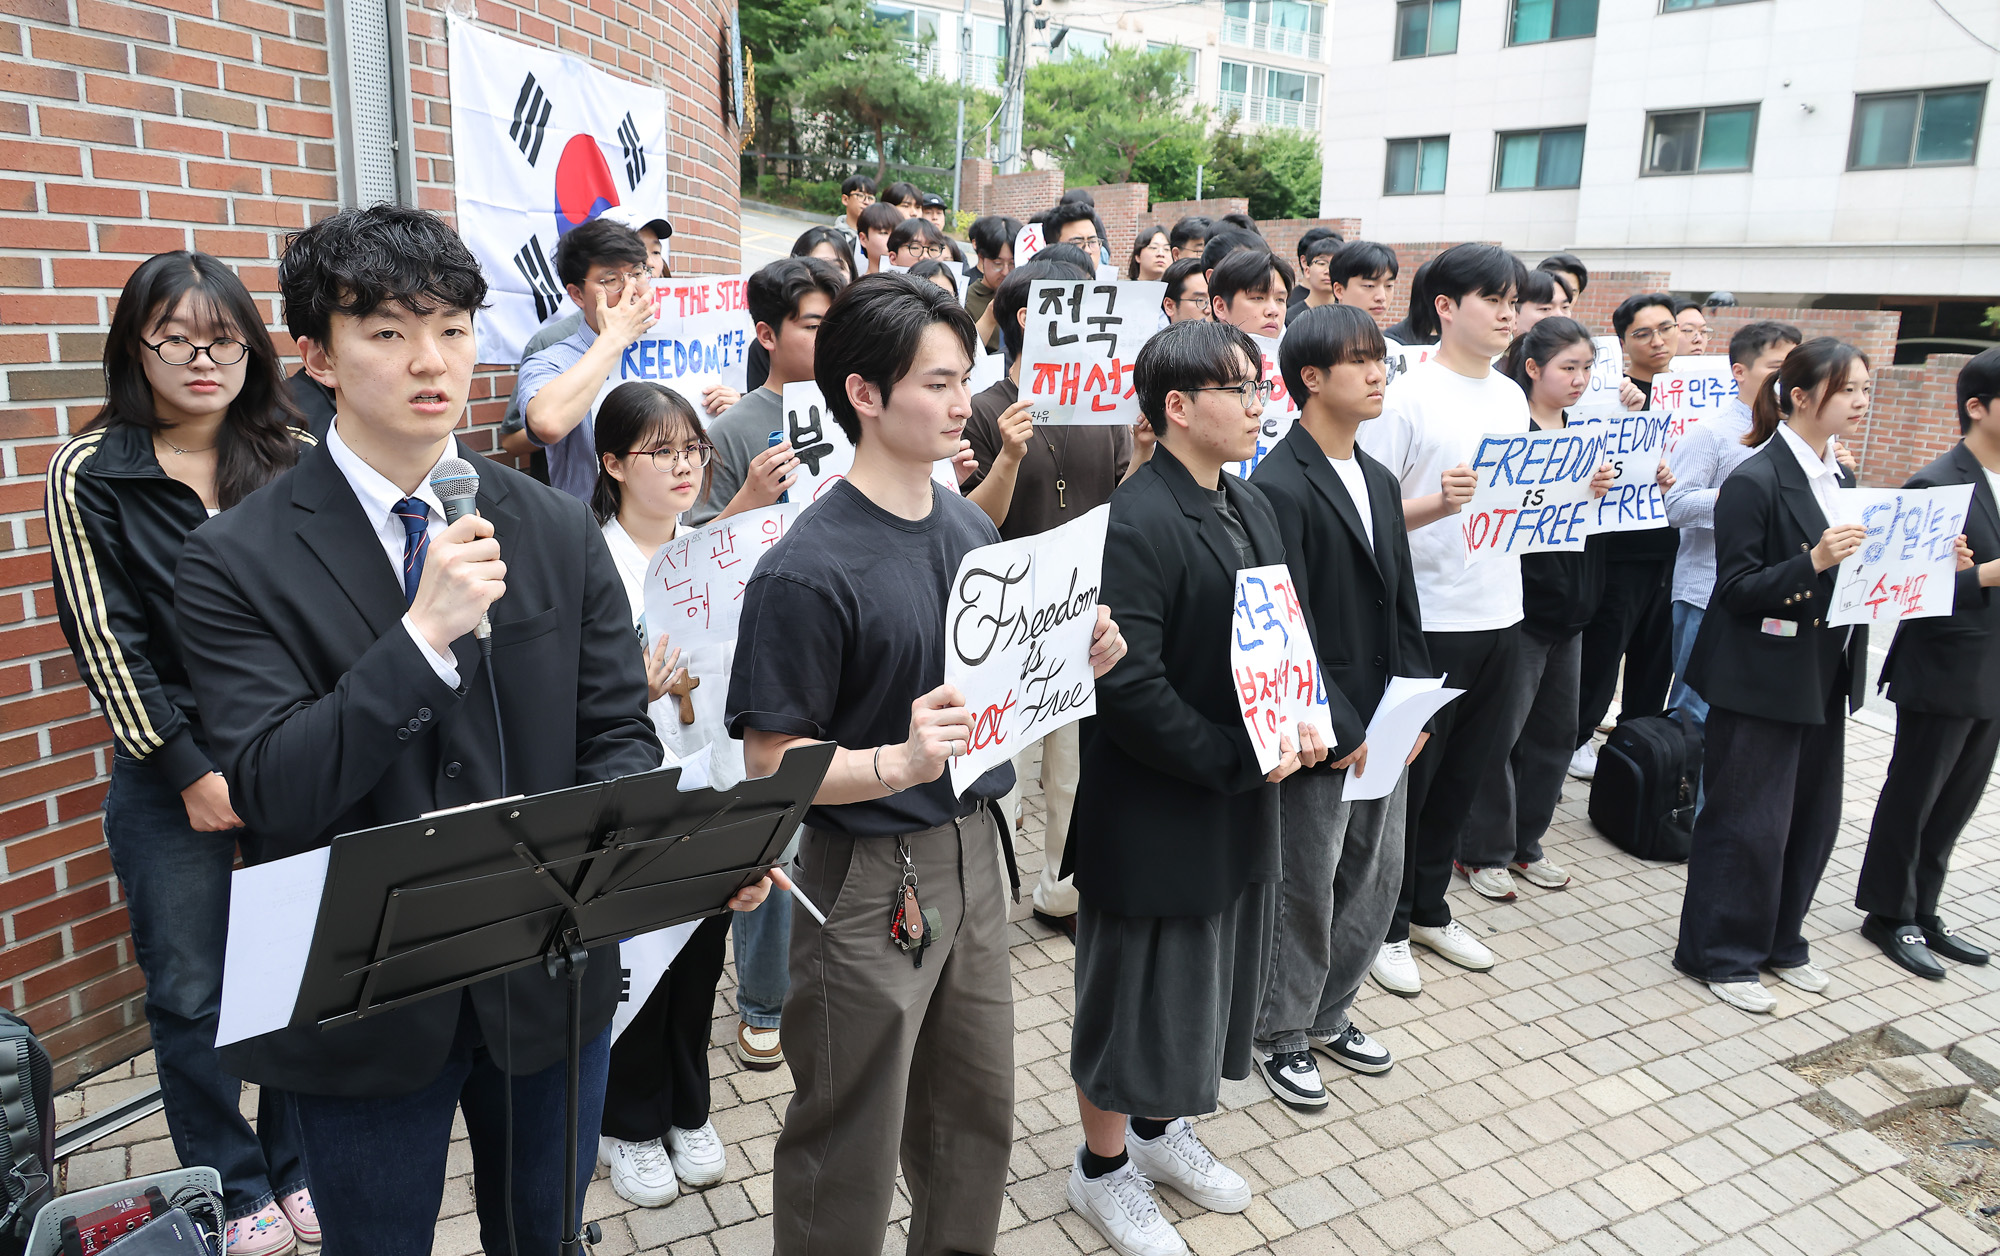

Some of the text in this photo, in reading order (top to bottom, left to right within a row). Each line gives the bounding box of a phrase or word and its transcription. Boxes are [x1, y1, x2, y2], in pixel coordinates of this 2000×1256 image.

[674, 284, 710, 318] THE
[1038, 284, 1123, 359] 전국
[611, 338, 721, 381] REEDOM
[717, 329, 746, 367] 민국
[788, 404, 838, 477] 부
[1472, 430, 1609, 488] FREEDOM
[1522, 488, 1545, 508] is
[1598, 482, 1666, 526] FREE
[1462, 501, 1589, 561] NOT FREE
[1862, 495, 1963, 566] 당일투표
[953, 553, 1098, 667] Freedom
[1864, 572, 1928, 620] 수개표
[1019, 639, 1047, 681] is
[1019, 658, 1097, 736] Free
